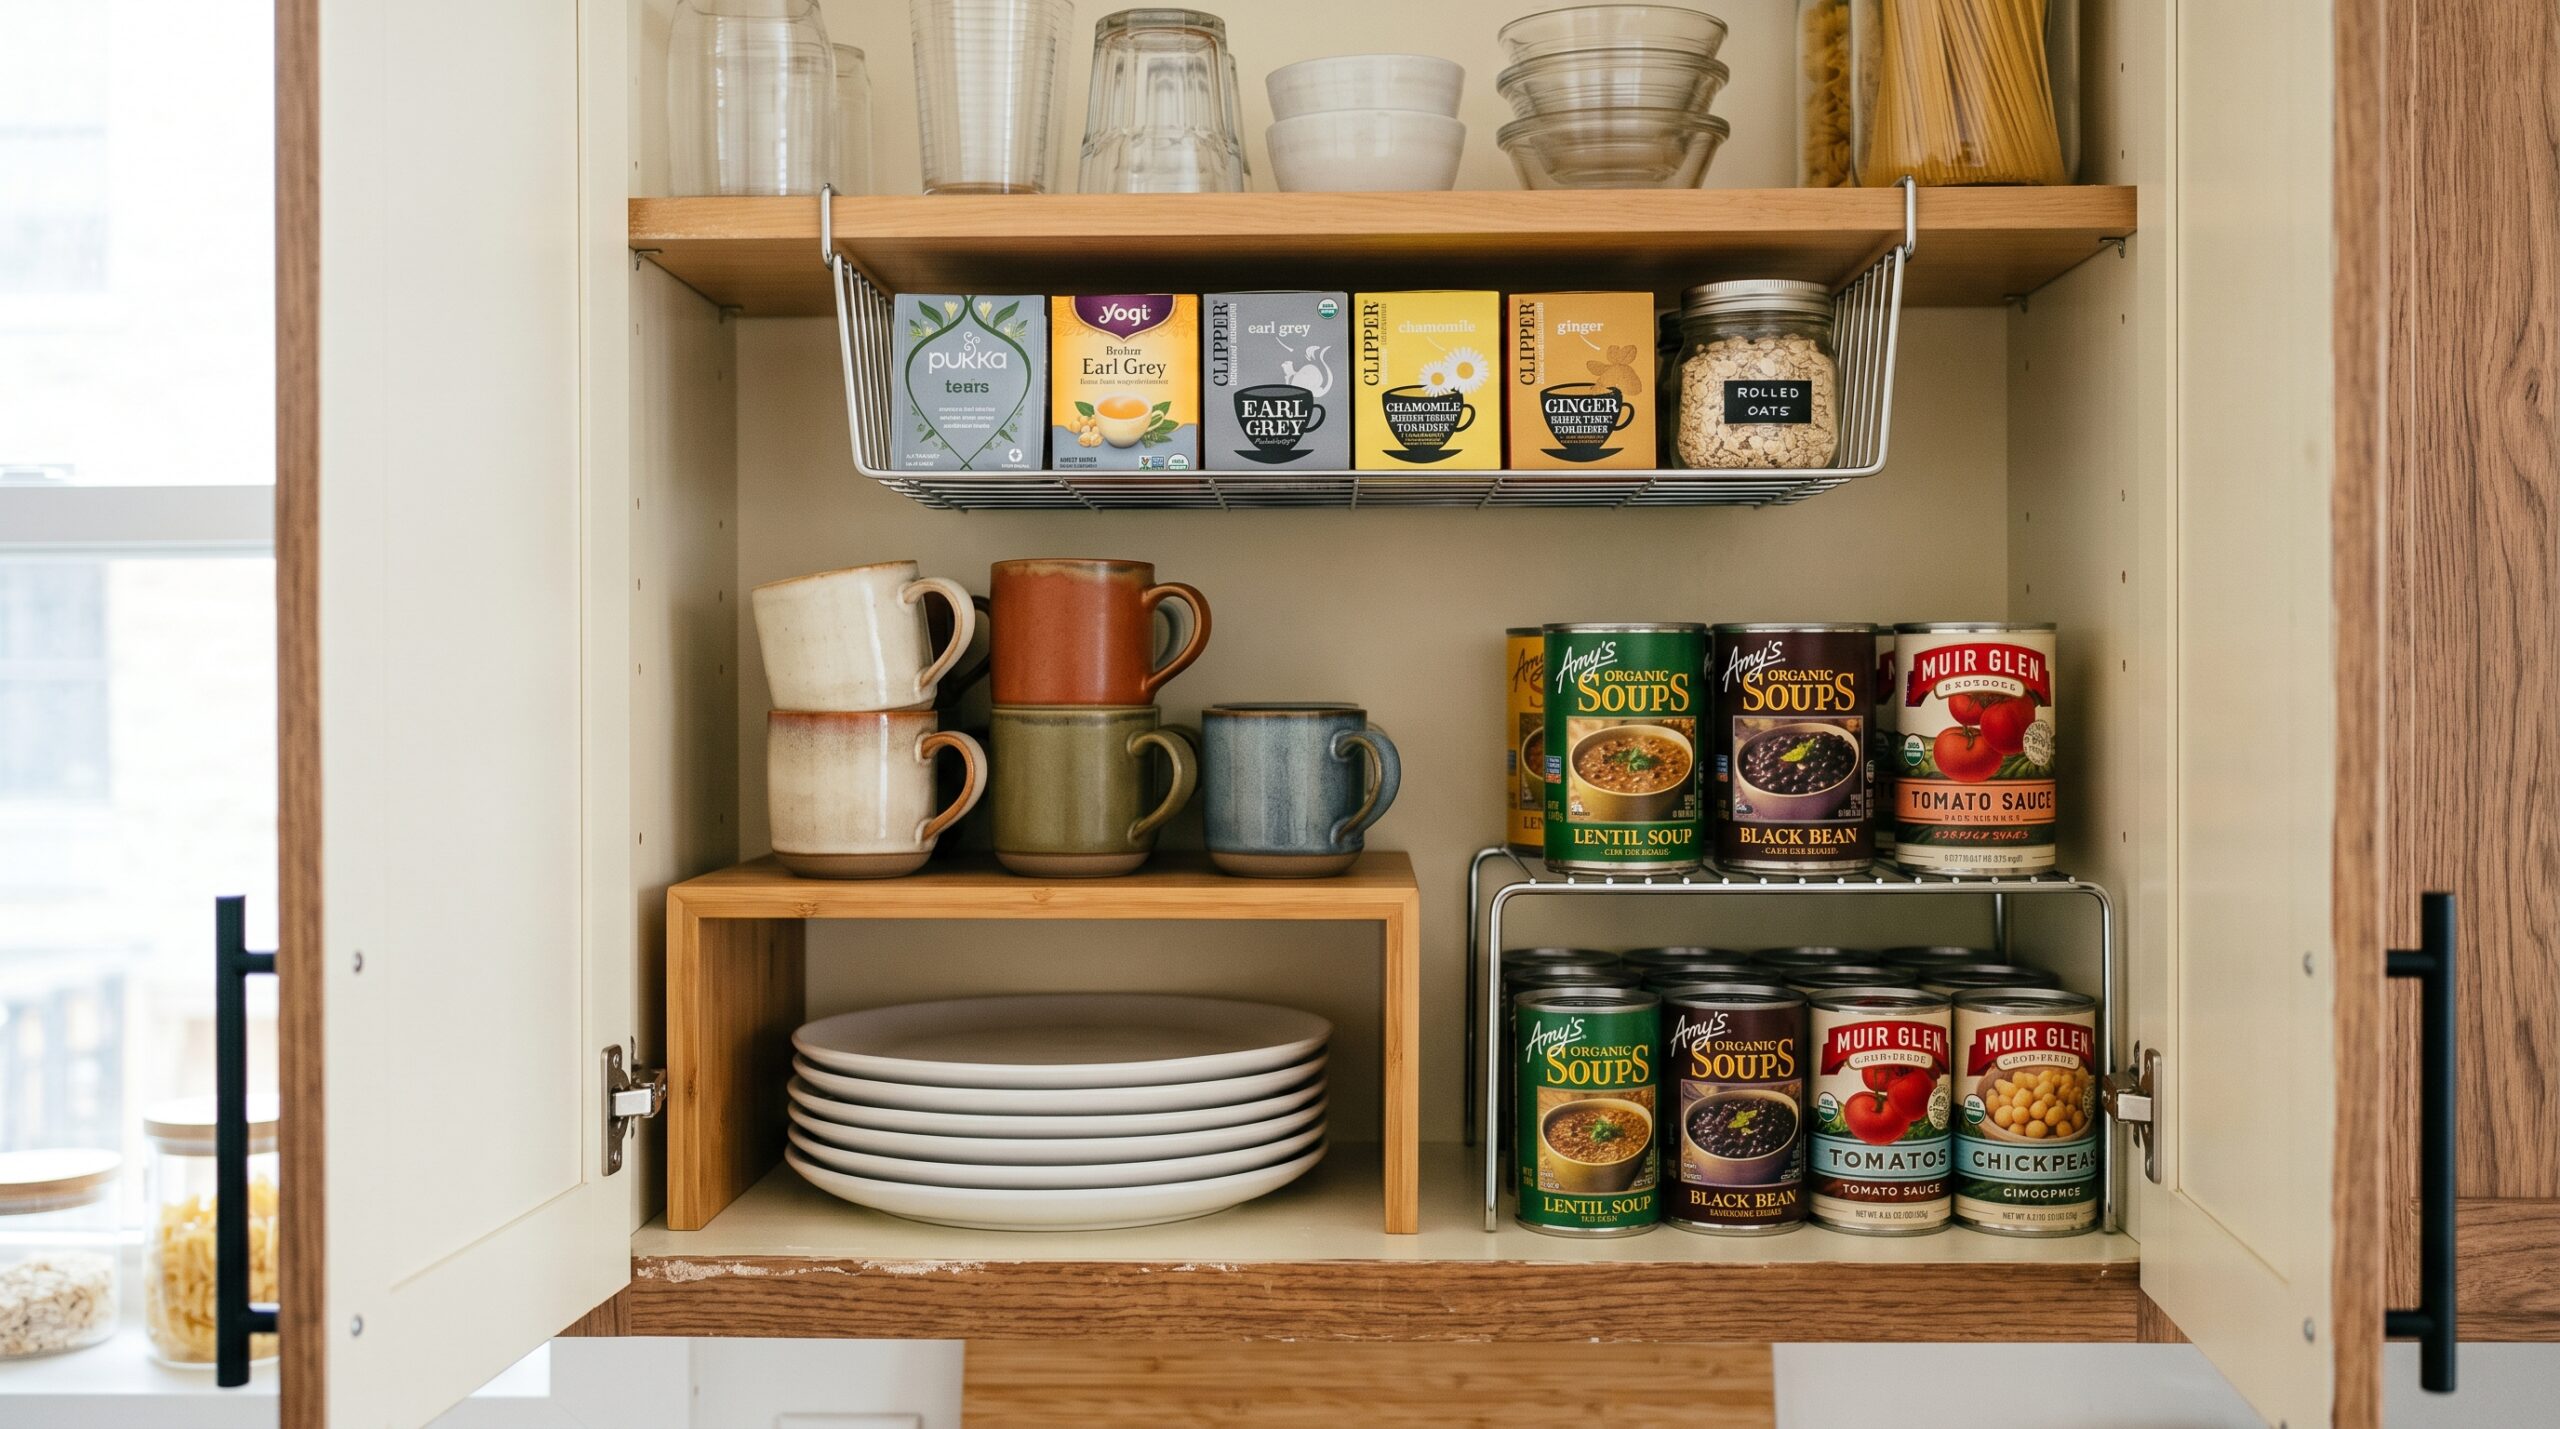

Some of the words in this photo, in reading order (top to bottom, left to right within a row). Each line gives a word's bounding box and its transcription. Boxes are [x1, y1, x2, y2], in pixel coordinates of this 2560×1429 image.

[1098, 303, 1151, 327] yogi
[1248, 321, 1276, 334] earl
[1279, 323, 1311, 337] grey
[1398, 320, 1476, 333] chamomile
[1557, 320, 1604, 336] ginger
[1213, 302, 1229, 387] CLIPPER
[1363, 302, 1379, 386] CLIPPER
[1520, 302, 1536, 386] CLIPPER
[1082, 358, 1119, 376] Earl
[1123, 358, 1167, 379] Grey
[945, 378, 990, 394] tears
[1737, 387, 1800, 398] ROLLED
[1241, 400, 1308, 418] EARL
[1386, 402, 1461, 412] CHAMOMILE
[1545, 398, 1620, 414] GINGER
[1747, 405, 1791, 416] OATS
[1246, 419, 1306, 436] GREY
[1555, 640, 1618, 694] Amy's
[1722, 640, 1786, 693] Amy's
[1768, 669, 1833, 681] ORGANIC
[1922, 649, 1977, 682] MUIR
[1988, 649, 2040, 682] GLEN
[1604, 670, 1669, 682] ORGANIC
[1577, 673, 1690, 712] SOUPS
[1742, 673, 1856, 711] SOUPS
[1911, 791, 1992, 811] TOMATO
[2002, 791, 2052, 811] SAUCE
[1574, 828, 1643, 846] LENTIL
[1647, 828, 1692, 845] SOUP
[1740, 827, 1804, 845] BLACK
[1808, 827, 1858, 845] BEAN
[1525, 1016, 1586, 1063] Amy's
[1670, 1011, 1731, 1058] Amy's
[1837, 1026, 1889, 1054] MUIR
[1897, 1026, 1941, 1054] GLEN
[1985, 1027, 2037, 1055] MUIR
[2046, 1027, 2088, 1055] GLEN
[1570, 1045, 1632, 1057] ORGANIC
[1714, 1040, 1777, 1051] ORGANIC
[1546, 1043, 1649, 1085] SOUPS
[1691, 1038, 1795, 1080] SOUPS
[1829, 1148, 1946, 1171] TOMATOS
[1690, 1189, 1750, 1209] BLACK
[1755, 1188, 1797, 1208] BEAN
[1842, 1183, 1898, 1197] TOMATO
[1903, 1183, 1941, 1197] SAUCE
[1543, 1196, 1608, 1215] LENTIL
[1611, 1195, 1652, 1214] SOUP
